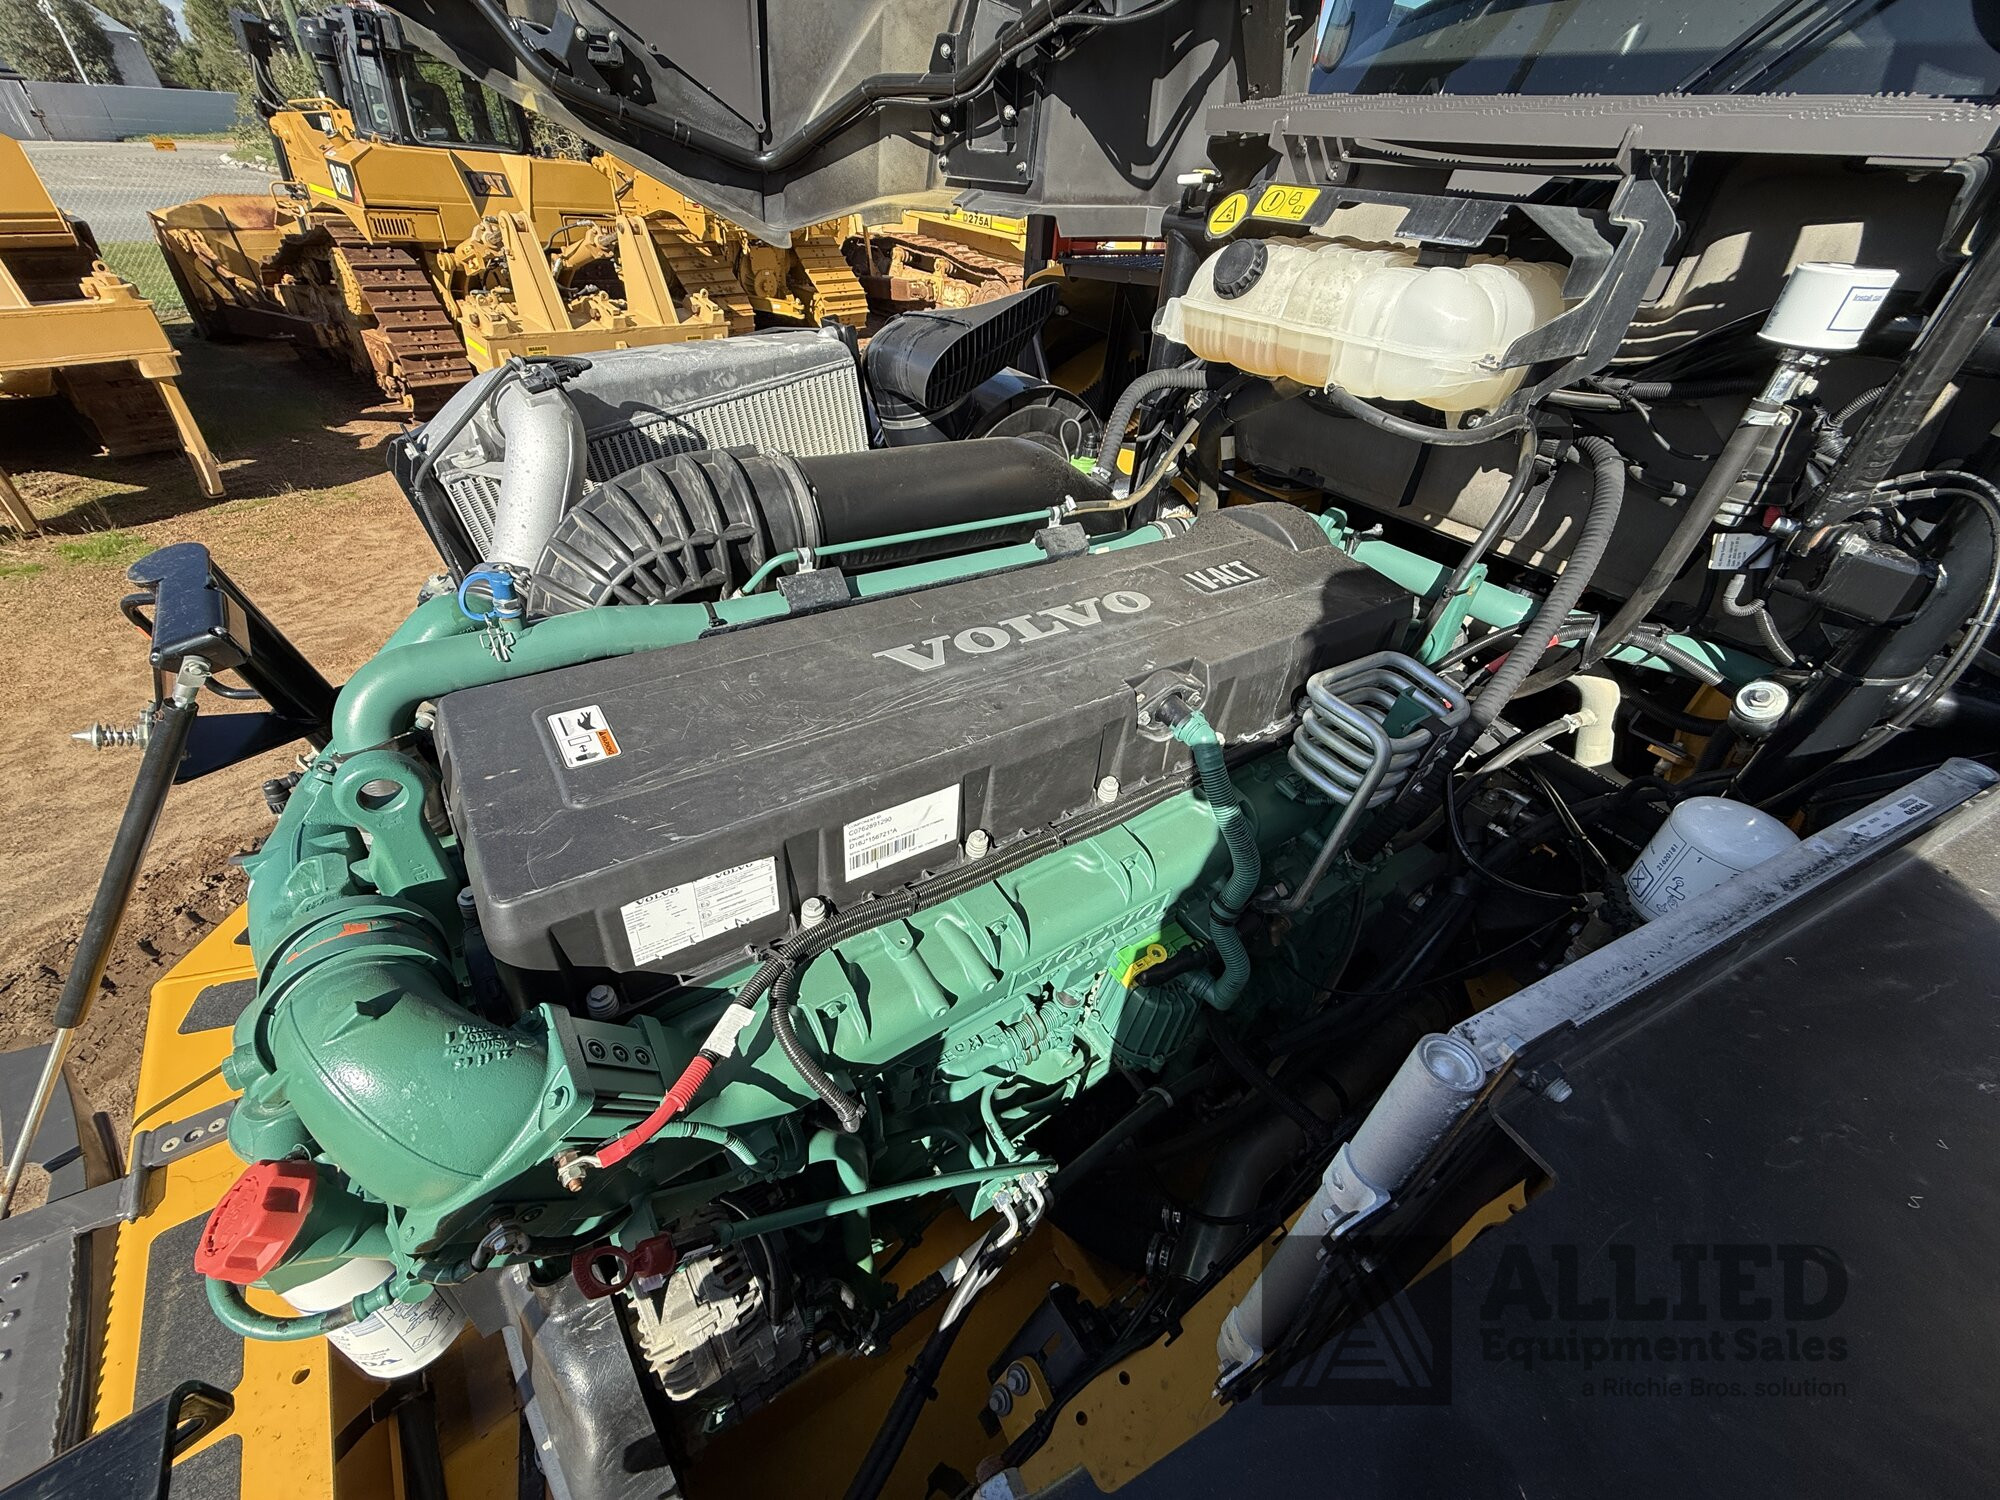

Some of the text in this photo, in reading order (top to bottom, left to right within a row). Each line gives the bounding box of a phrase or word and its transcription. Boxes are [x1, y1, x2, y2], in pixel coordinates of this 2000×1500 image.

[329, 163, 353, 198] CAT
[470, 174, 507, 195] CAT
[963, 213, 989, 227] D275A
[1184, 560, 1260, 591] V-ACT
[872, 591, 1151, 671] VOLVO
[1656, 843, 1680, 872] 21620181
[715, 863, 754, 879] VOLVO
[635, 887, 679, 906] VOLVO
